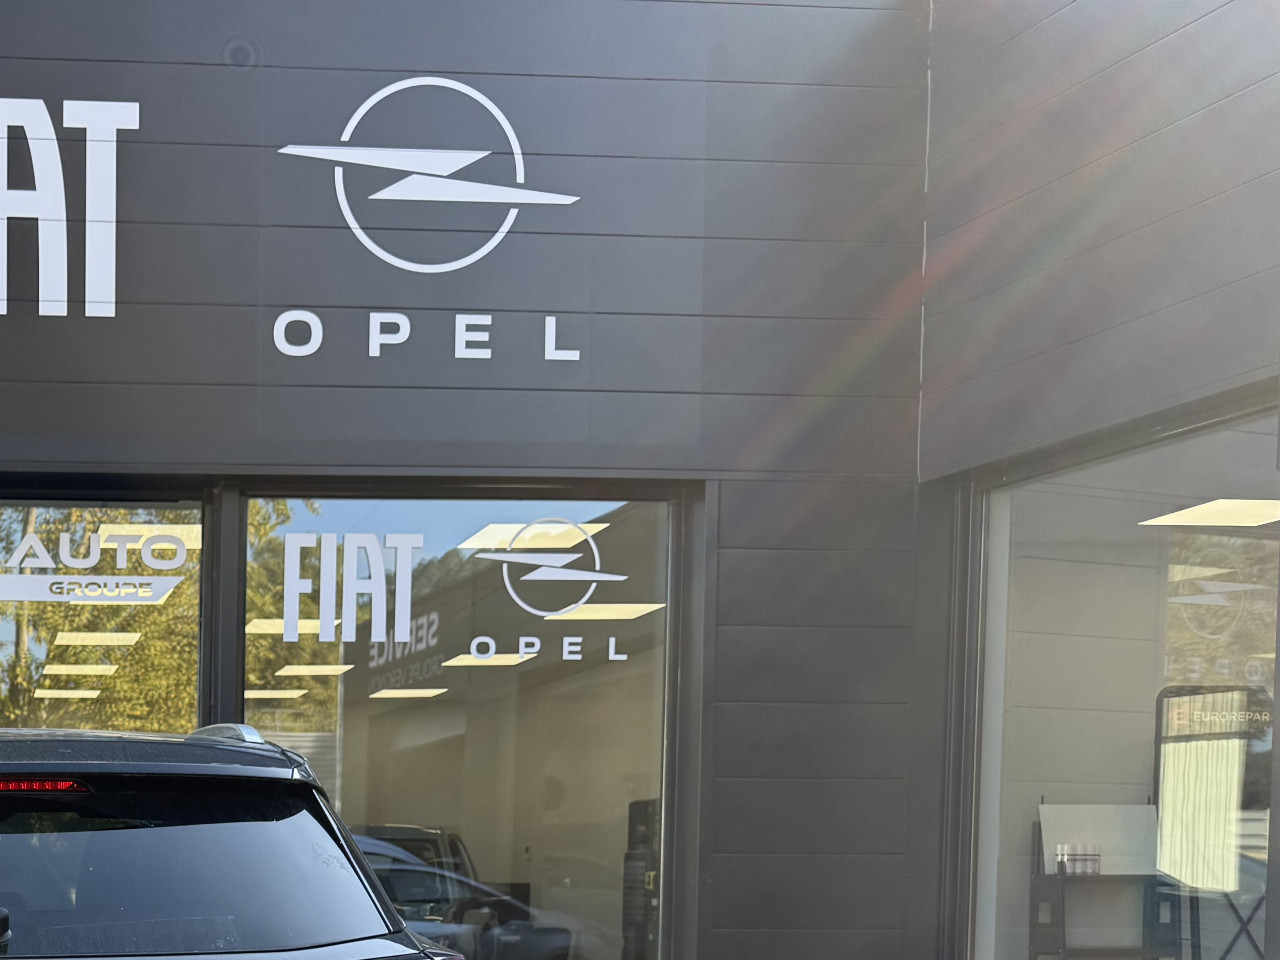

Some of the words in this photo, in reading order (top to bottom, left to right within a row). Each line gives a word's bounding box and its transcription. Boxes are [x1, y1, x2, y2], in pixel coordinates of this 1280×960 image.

[273, 309, 581, 361] OPEL
[5, 531, 188, 570] AUTO
[48, 581, 154, 598] GROUPE
[282, 532, 424, 642] FIAT
[469, 635, 628, 661] OPEL
[1193, 711, 1271, 722] EUROREPAR
